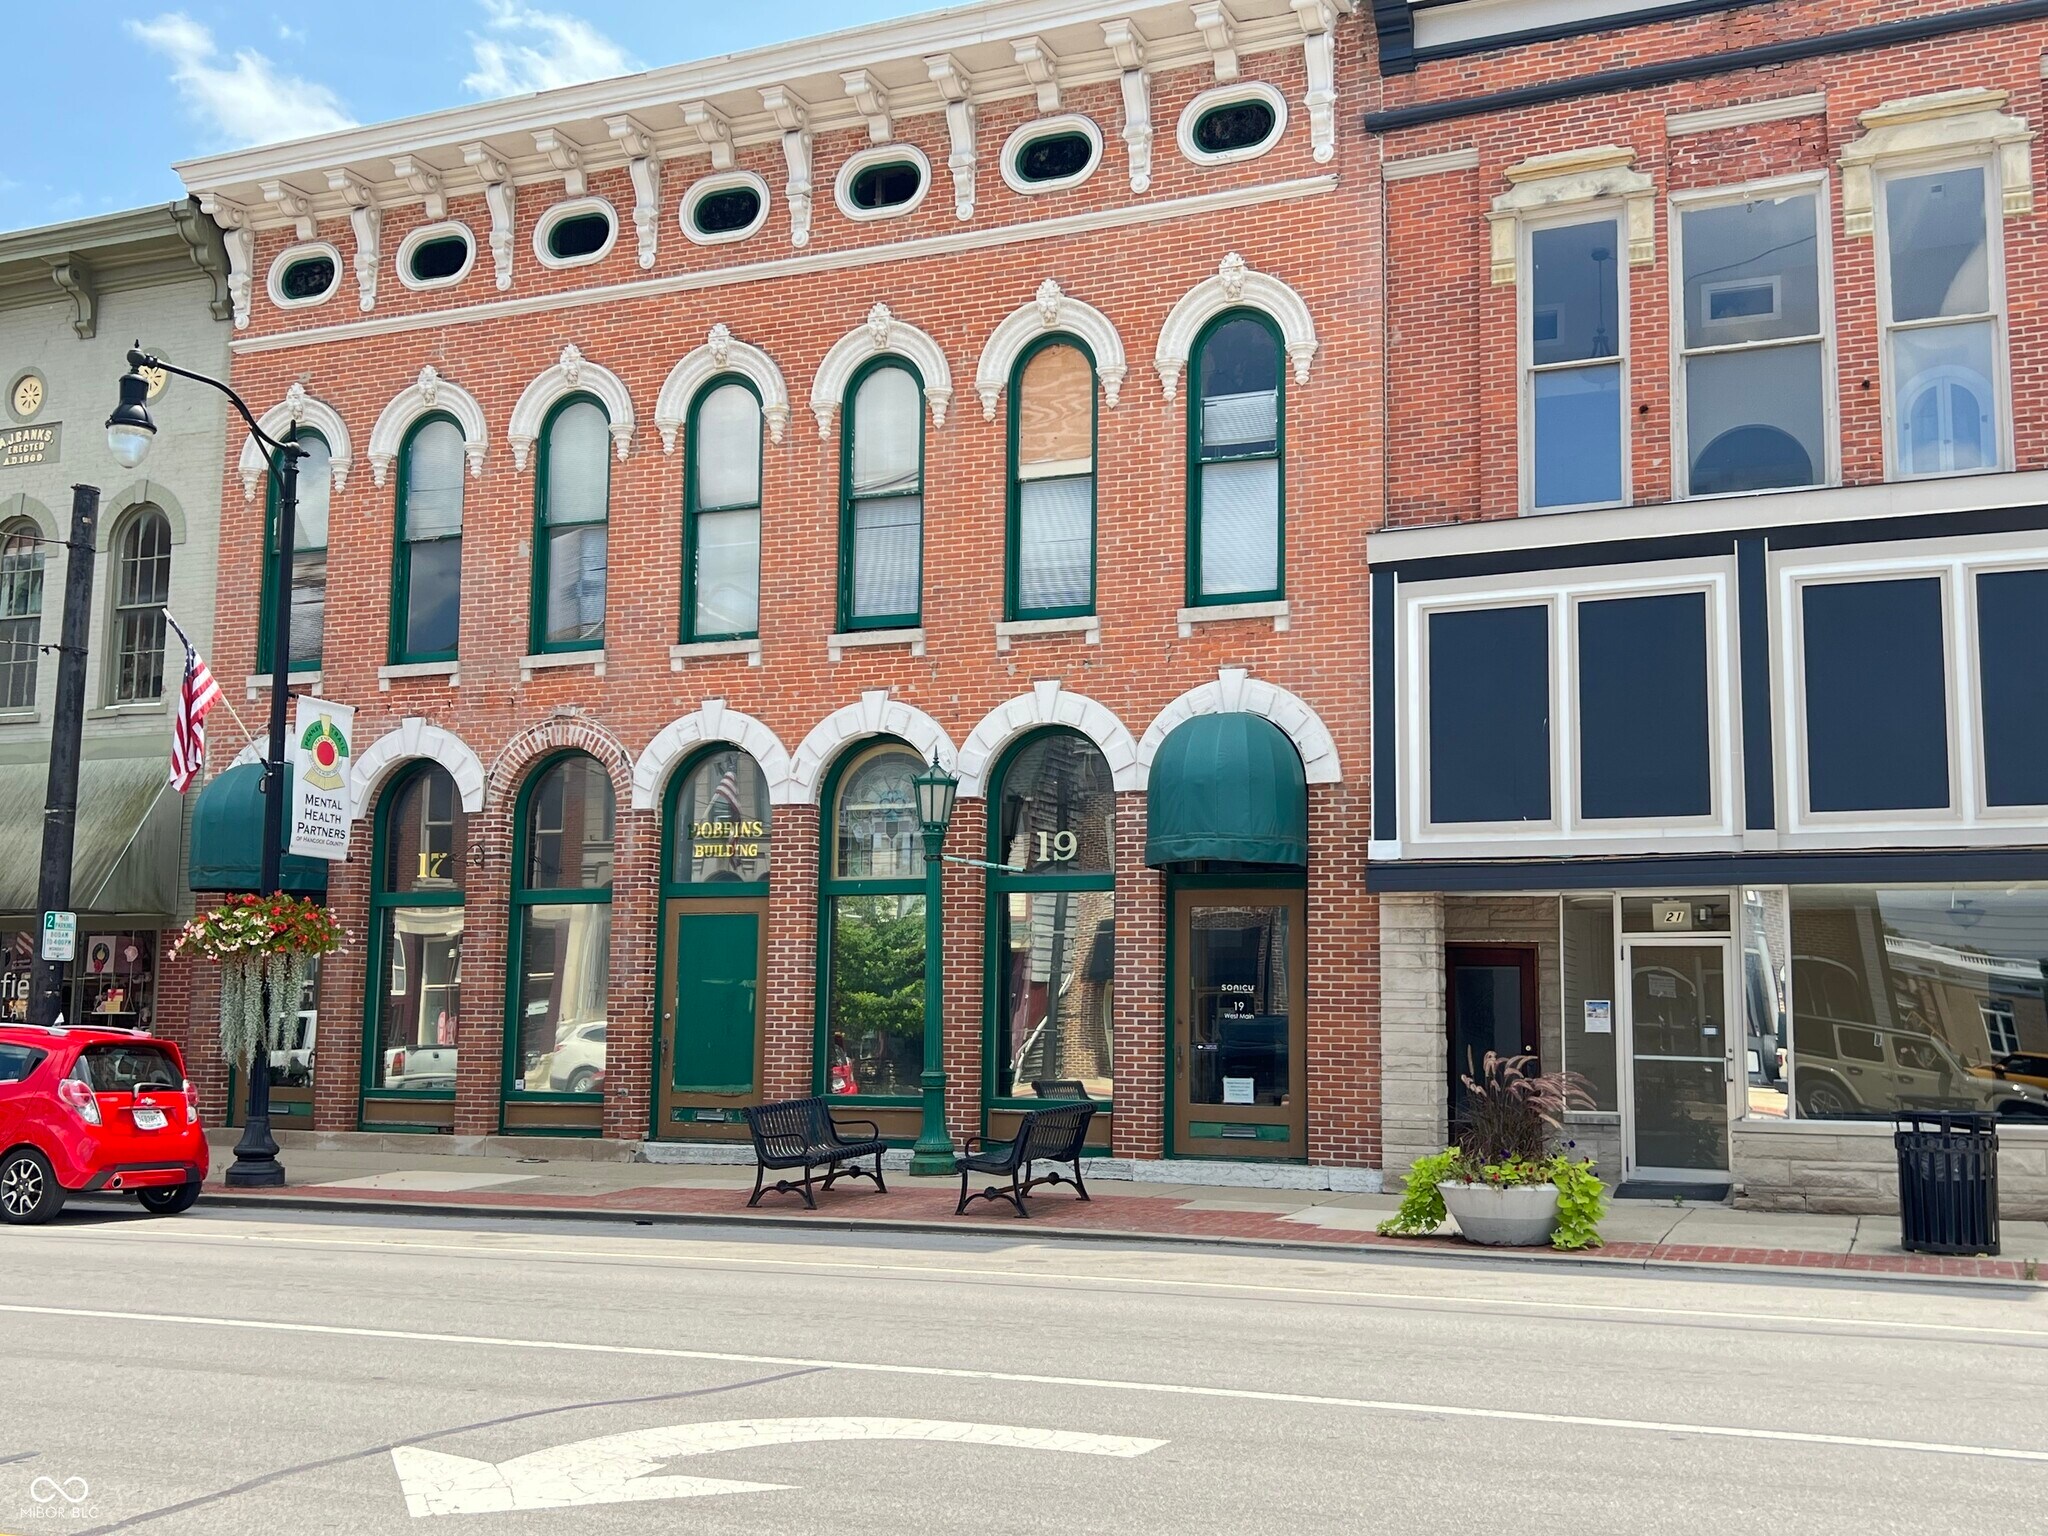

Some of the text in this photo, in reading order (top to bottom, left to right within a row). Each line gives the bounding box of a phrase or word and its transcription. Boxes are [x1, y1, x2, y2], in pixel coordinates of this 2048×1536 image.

[8, 442, 45, 454] ERECTED
[331, 727, 346, 751] TRAIL
[305, 794, 343, 810] MENTAL
[304, 808, 341, 824] HEALTH
[297, 822, 346, 839] PARTNERS
[694, 844, 758, 858] BUILDING
[1036, 830, 1077, 861] 19
[417, 853, 448, 878] 17
[47, 915, 54, 928] 2
[1665, 911, 1682, 922] 21
[1233, 1001, 1245, 1011] 19
[1239, 1012, 1255, 1020] Main
